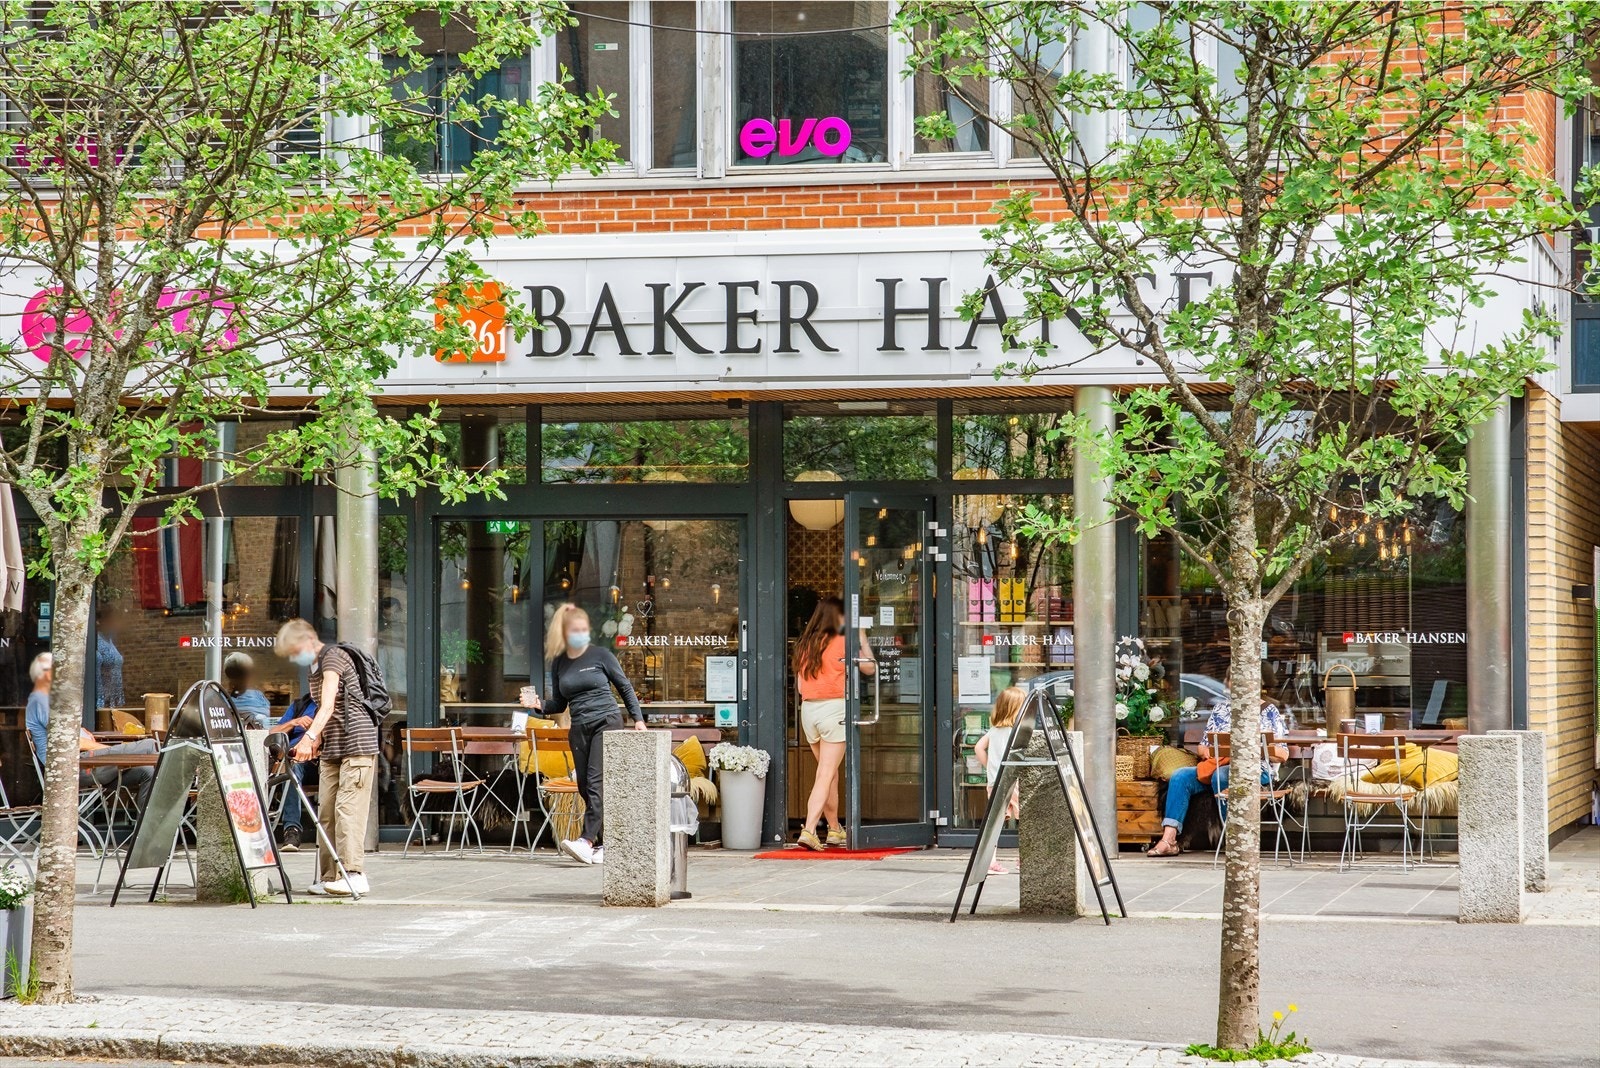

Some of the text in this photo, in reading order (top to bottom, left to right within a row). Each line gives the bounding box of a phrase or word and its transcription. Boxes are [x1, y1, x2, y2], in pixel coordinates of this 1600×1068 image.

[739, 117, 851, 158] evo
[523, 271, 1300, 357] BAKER HANSE
[442, 320, 506, 355] 61
[191, 636, 233, 648] BAKER
[236, 636, 277, 648] HANS
[628, 635, 670, 647] BAKER
[673, 635, 728, 647] HANSEN
[995, 635, 1037, 646] BAKER
[1043, 634, 1074, 646] HAN
[1356, 633, 1402, 644] BAKER
[1406, 632, 1467, 644] HANSEN
